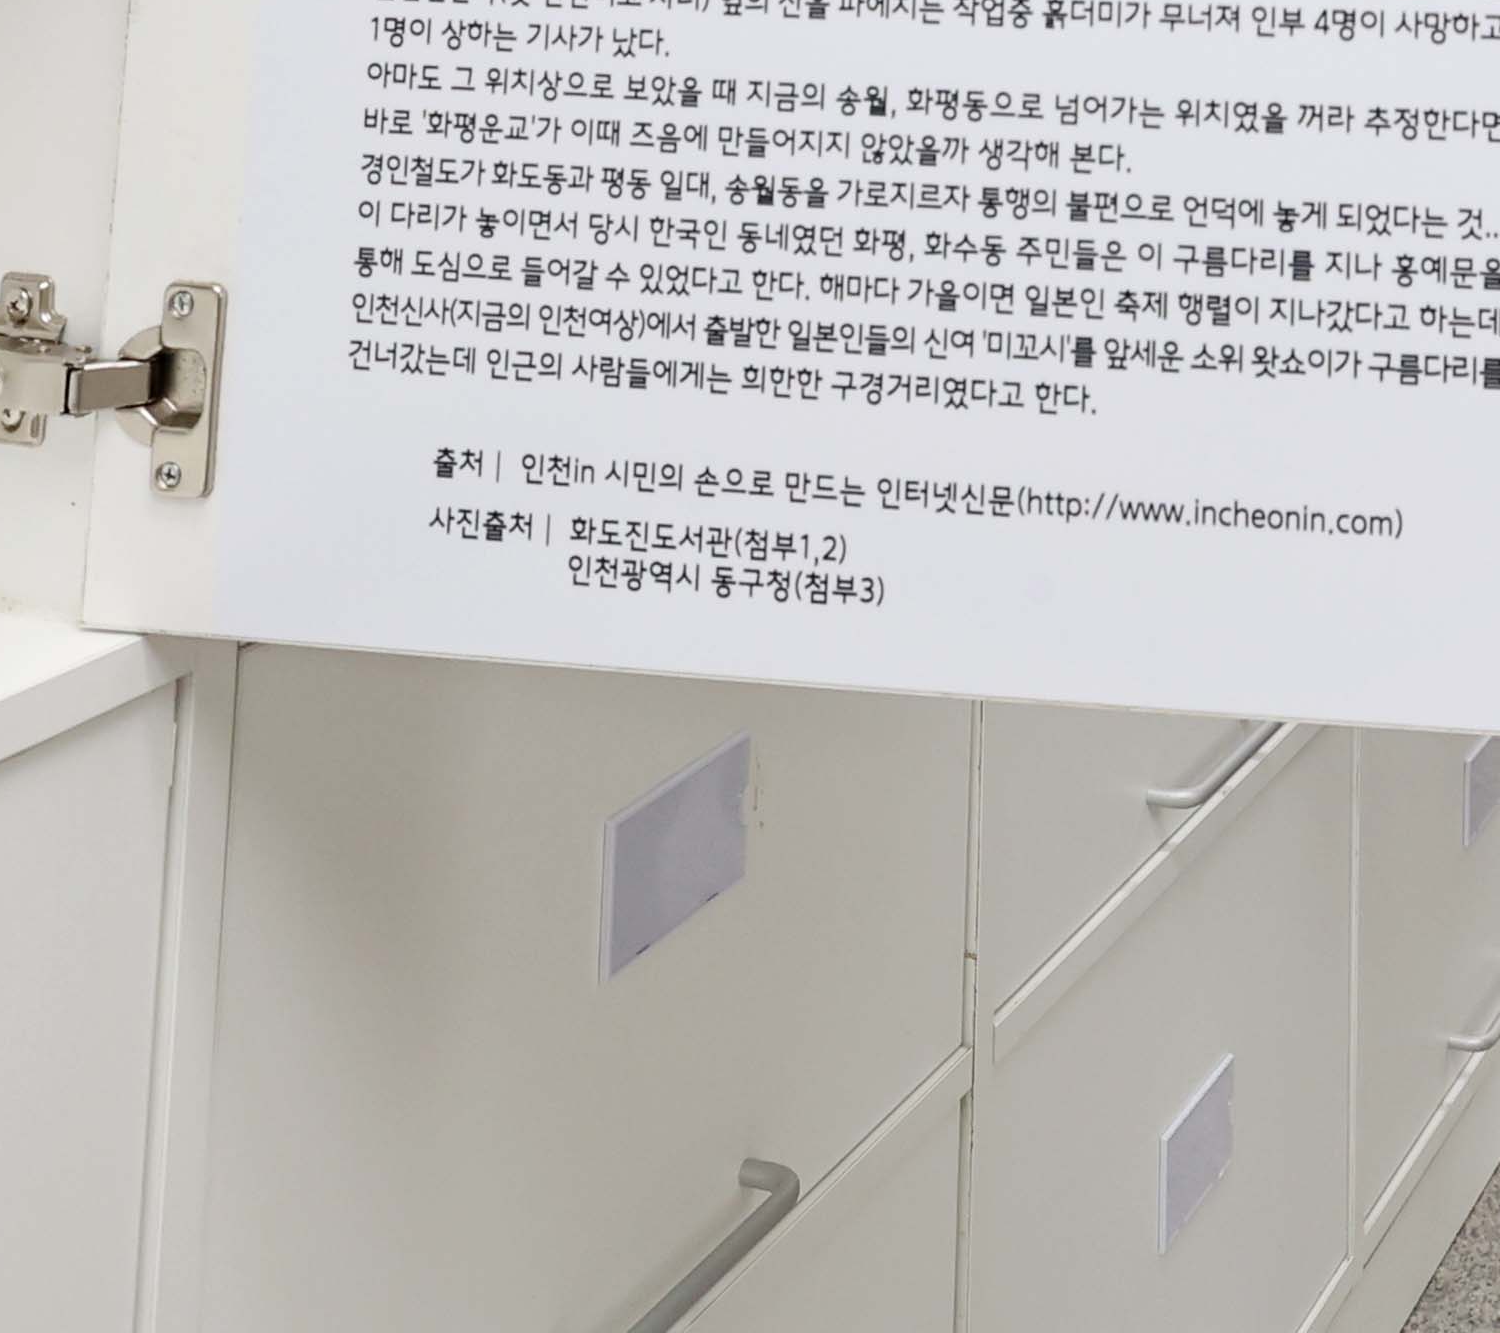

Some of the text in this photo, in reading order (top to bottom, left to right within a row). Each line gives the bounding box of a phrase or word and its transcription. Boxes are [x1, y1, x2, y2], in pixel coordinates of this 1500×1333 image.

[370, 15, 671, 59] 1명이 상하는 기사가 났다.
[362, 107, 414, 136] 바로
[570, 117, 622, 149] 이때
[628, 120, 709, 155] 즈음에
[716, 124, 851, 160] 만들어지지
[860, 131, 971, 169] 않았을까
[977, 137, 1061, 172] 생각해
[1068, 142, 1132, 176] 본다.
[347, 338, 1097, 417] 건너갔는데 인근의 사람들에게는 희한한 구경거리였다고 한다.
[431, 446, 1404, 540] 출처 인천in 시민의 손으로 만드는 인터넷신문(http://www.incheonin.com)
[427, 505, 848, 568] 사진출처 화도진도서관(첨부1,2)
[567, 553, 886, 608] 인천광역시 동구청(첨부3)
